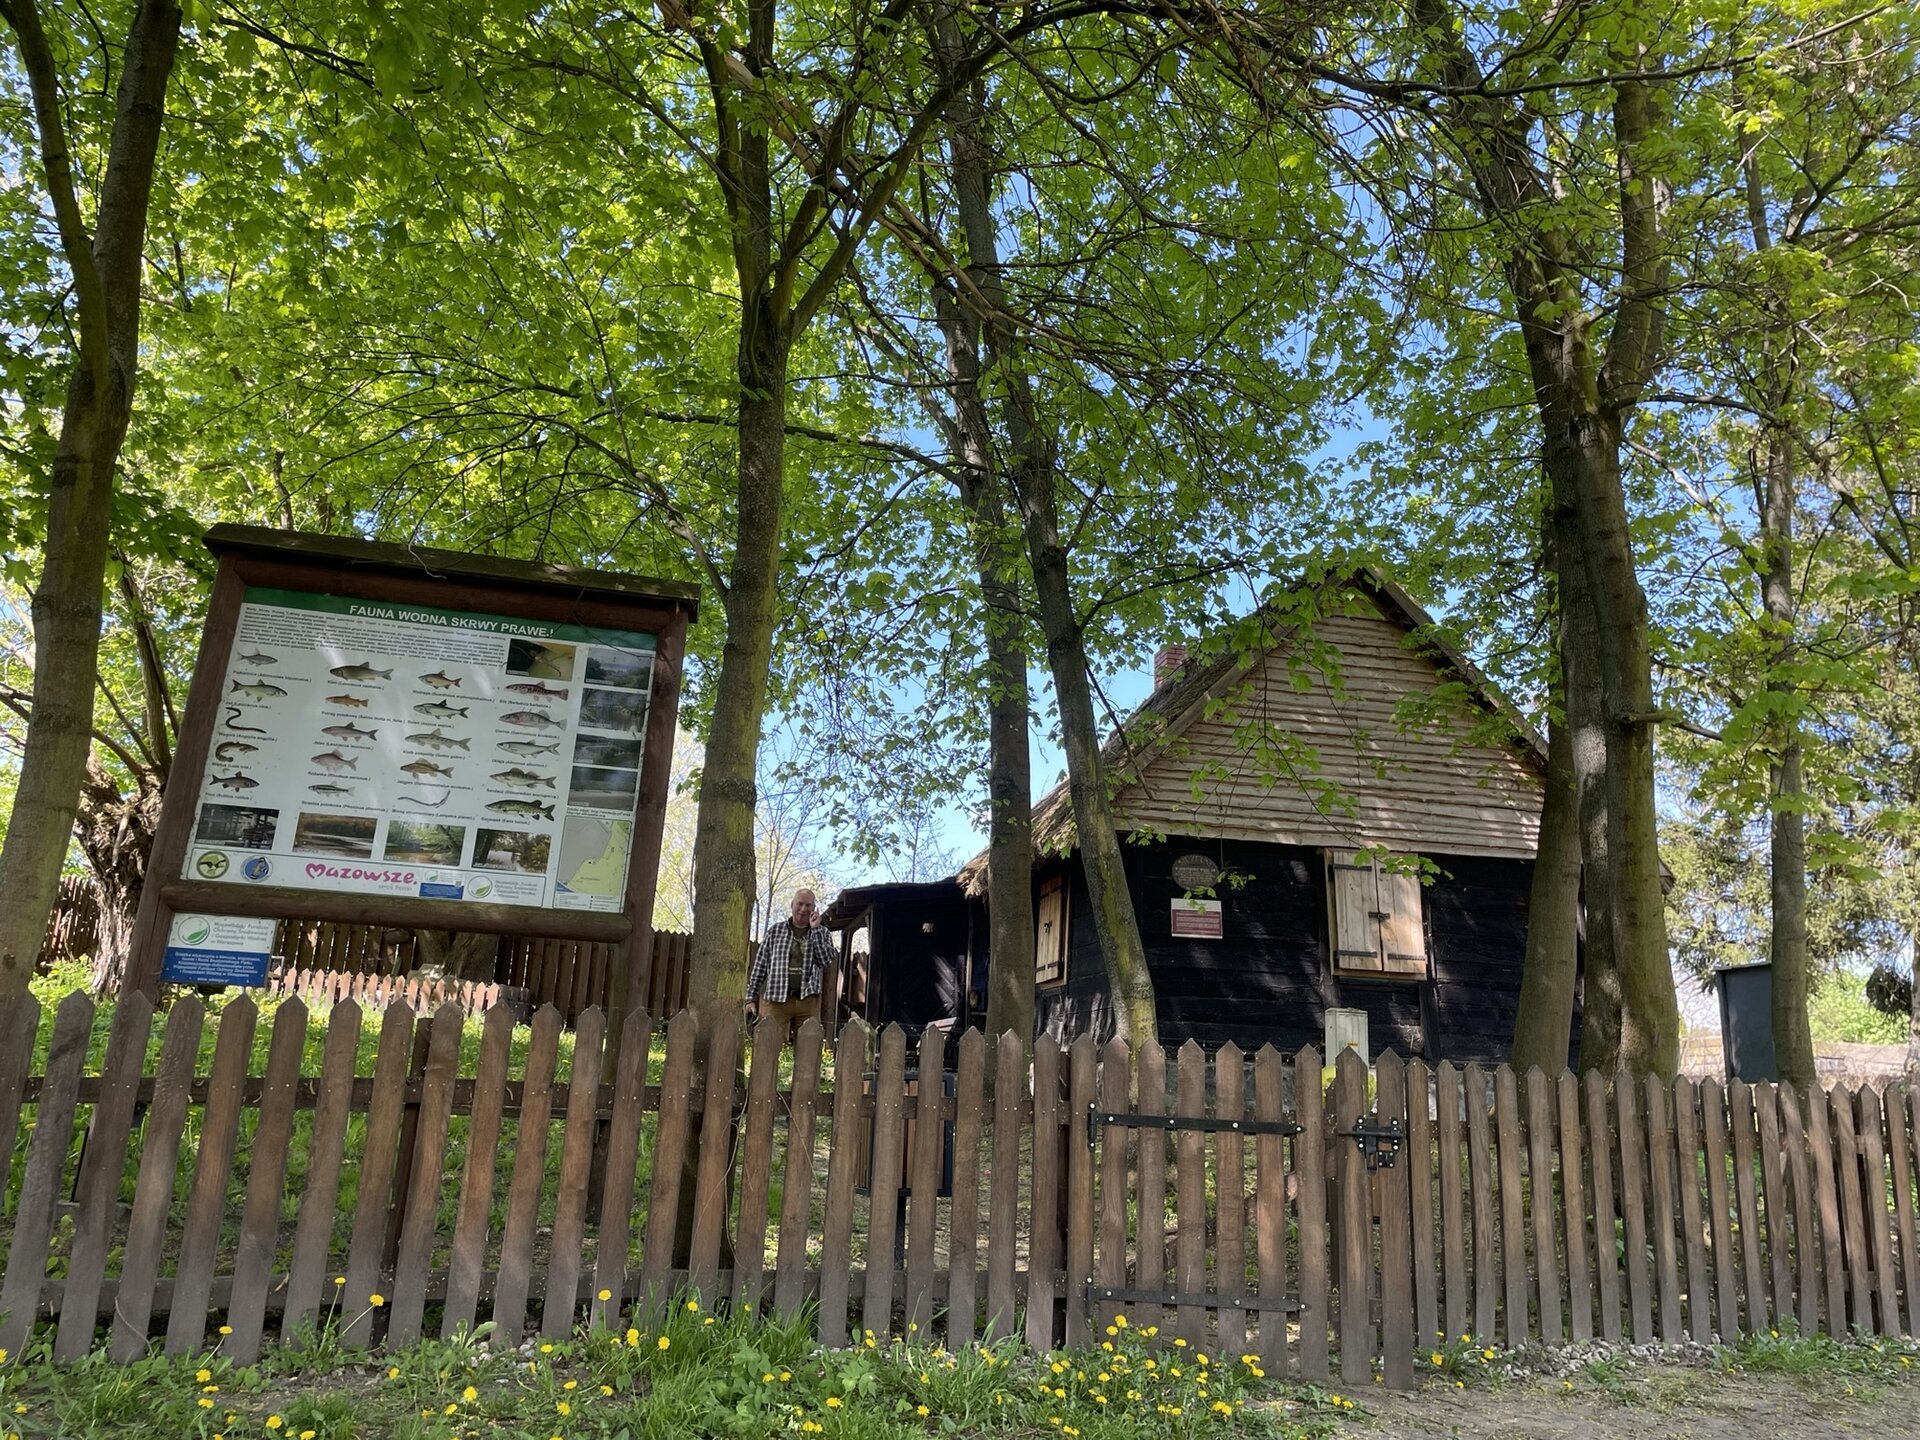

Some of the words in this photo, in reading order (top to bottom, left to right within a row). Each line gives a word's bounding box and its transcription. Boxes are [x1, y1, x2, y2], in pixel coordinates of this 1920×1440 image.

[349, 605, 395, 619] FAUNA
[398, 610, 448, 625] WODNA
[451, 617, 498, 631] SKRWY
